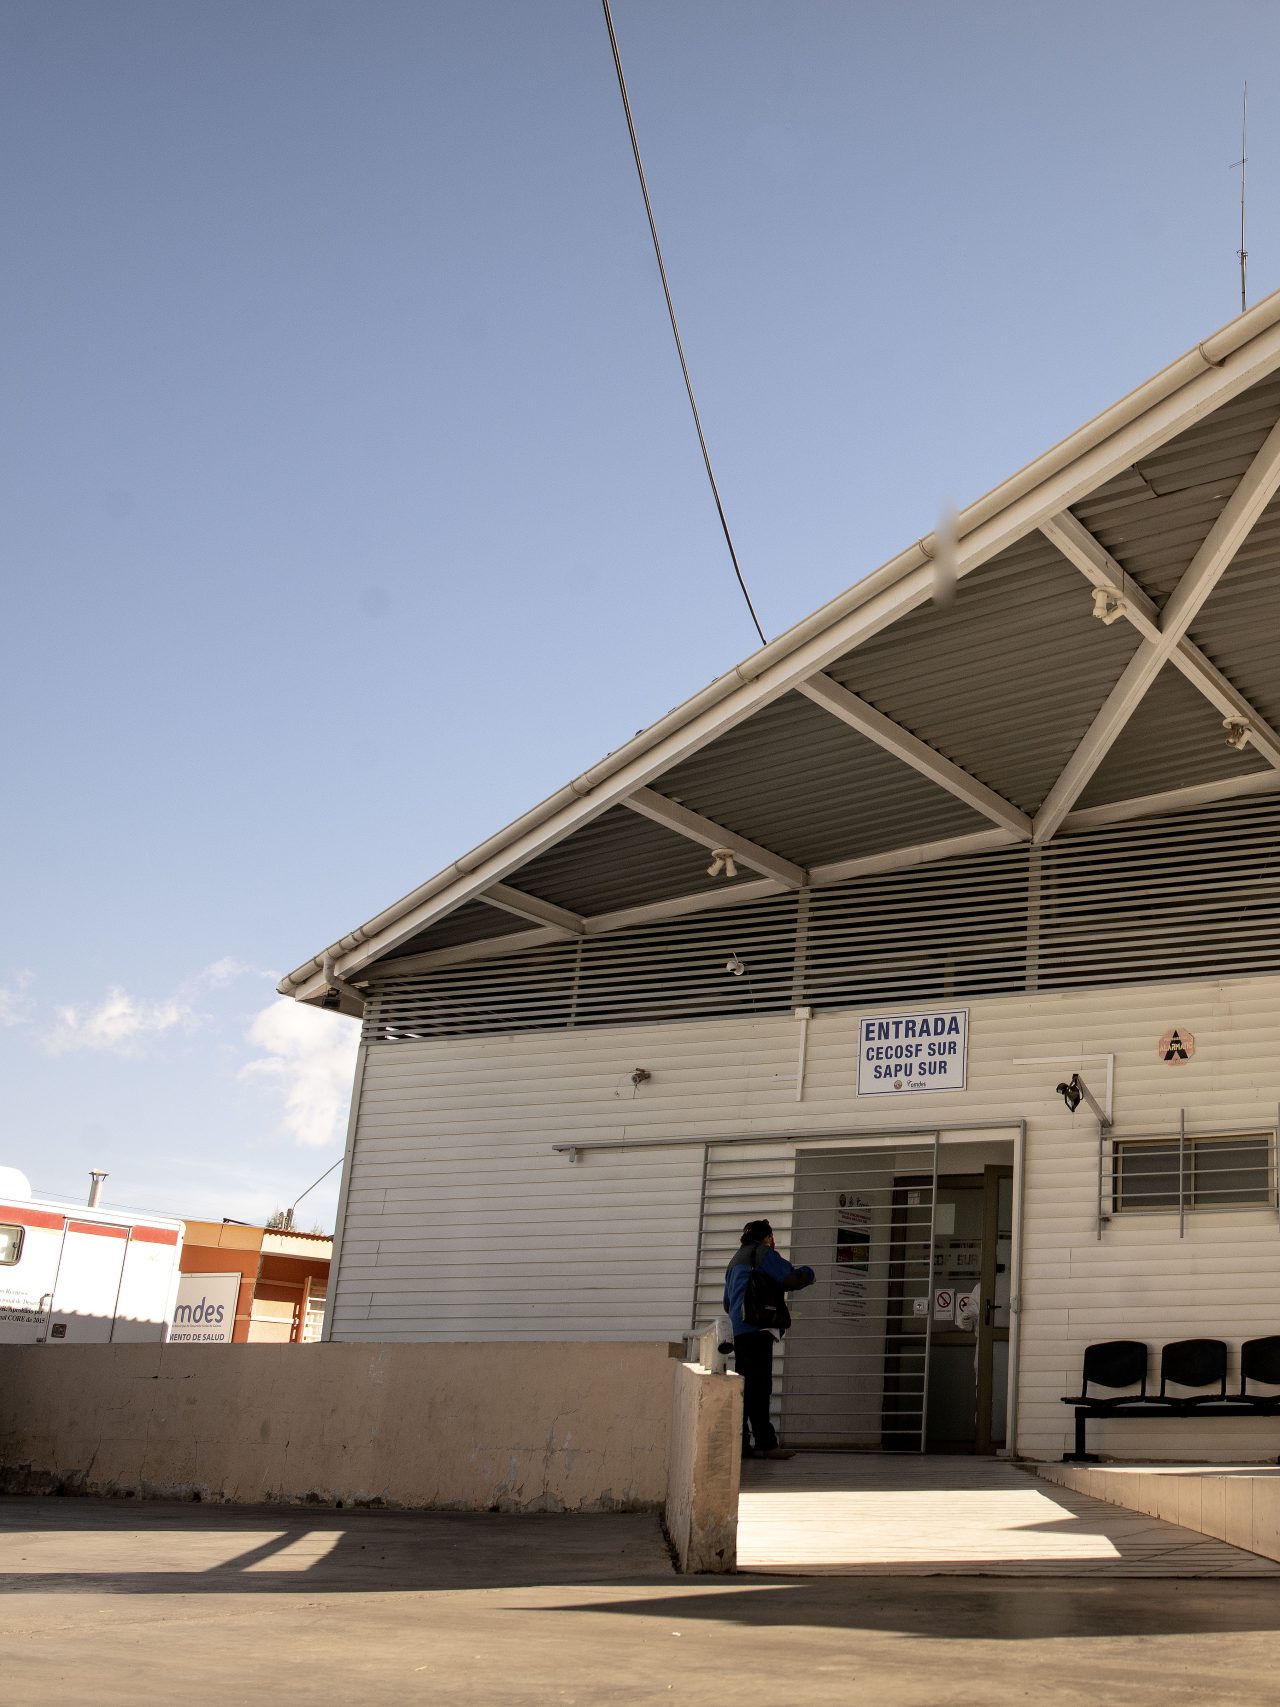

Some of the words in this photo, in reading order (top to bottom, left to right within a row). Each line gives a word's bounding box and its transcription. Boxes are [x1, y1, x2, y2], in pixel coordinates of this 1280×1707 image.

[865, 1016, 960, 1041] ENTRADA
[866, 1043, 923, 1061] CECOSF
[927, 1041, 957, 1057] SUR
[874, 1062, 913, 1080] SAPU
[918, 1060, 948, 1076] SUR
[7, 1314, 26, 1323] CORE
[173, 1296, 225, 1324] mdes
[170, 1333, 192, 1341] MENTO
[192, 1333, 201, 1341] DE
[202, 1333, 225, 1341] SALUD
